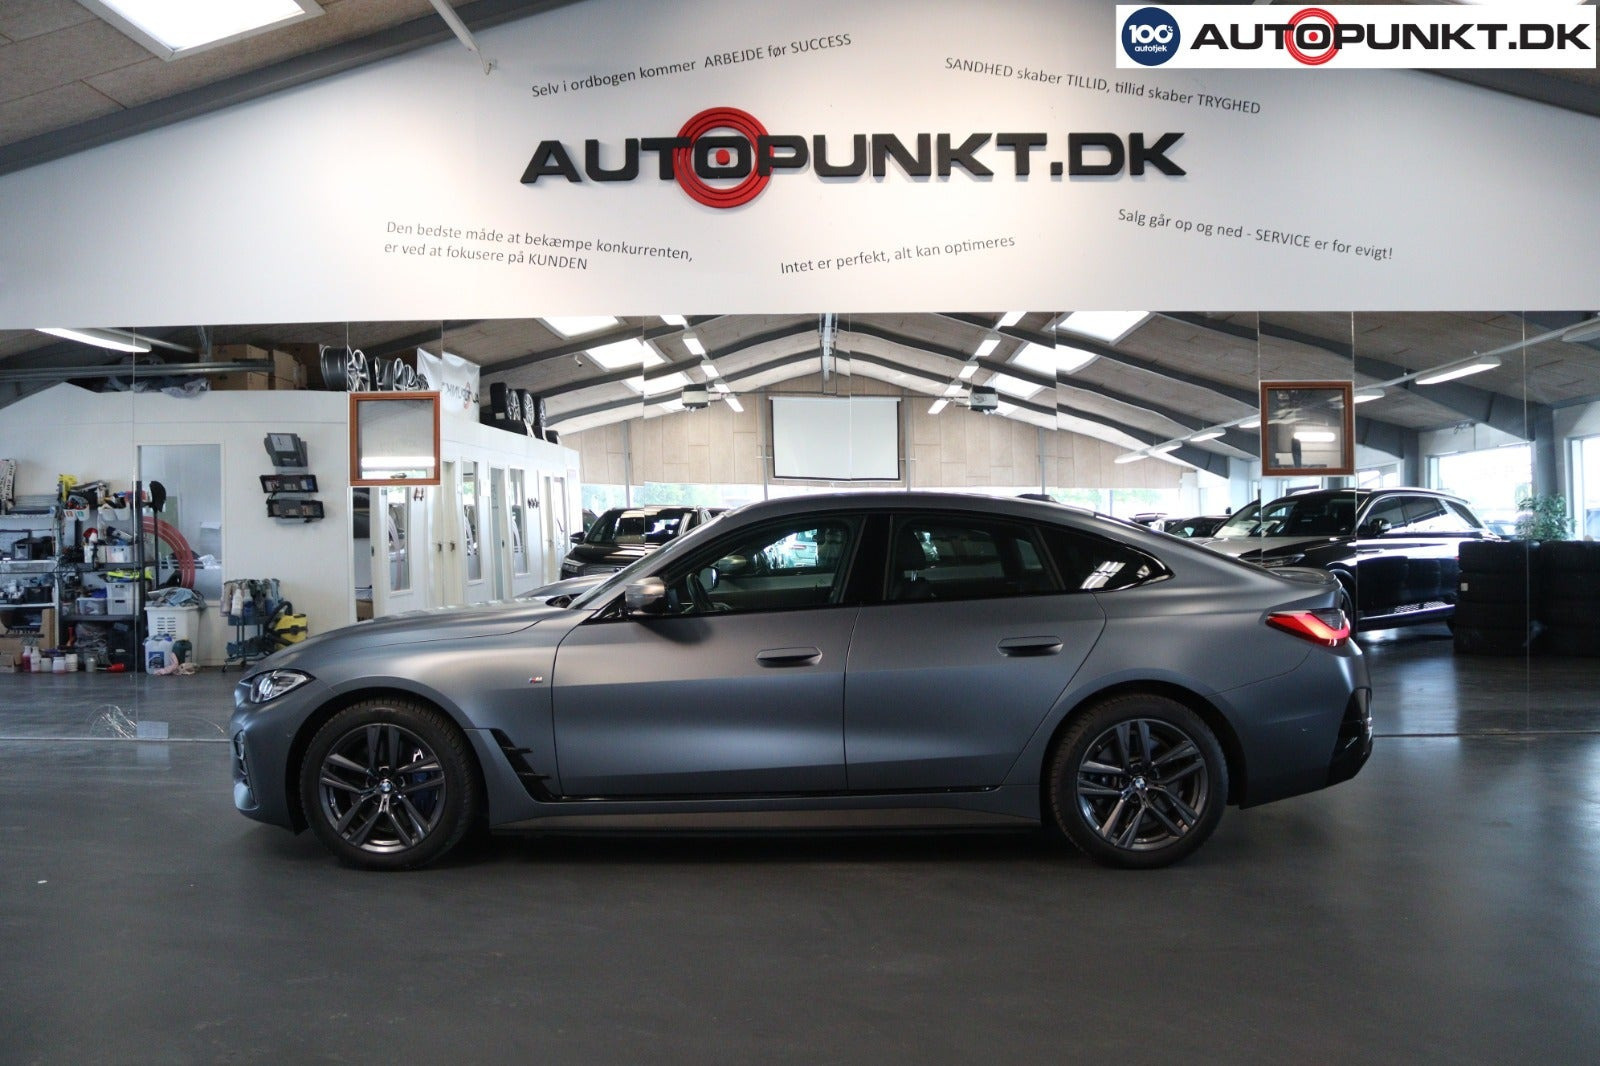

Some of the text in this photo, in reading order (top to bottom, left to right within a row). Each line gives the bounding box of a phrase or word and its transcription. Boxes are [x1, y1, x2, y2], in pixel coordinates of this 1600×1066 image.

[531, 33, 852, 98] Selv i ordbogen kommer ARBEJDE før SUCCESS
[944, 56, 1261, 115] SANDHED skaber TILLID, tillid skaber TRYGHED
[521, 132, 1186, 184] AUTOPUNKT.DK
[384, 242, 588, 271] er ved at fokusere på KUNDEN
[386, 221, 693, 263] Den bedste måde at bekæmpe konkurrenten,
[780, 236, 1016, 275] Intet er perfekt, alt kan optimeres
[1117, 208, 1147, 227] Salg
[1148, 212, 1172, 229] går
[1174, 219, 1193, 233] op
[1195, 222, 1214, 237] og
[1216, 225, 1244, 239] ned
[1255, 228, 1311, 249] SERVICE
[1314, 239, 1330, 251] er
[1331, 238, 1352, 254] for
[1354, 244, 1393, 262] evigt!
